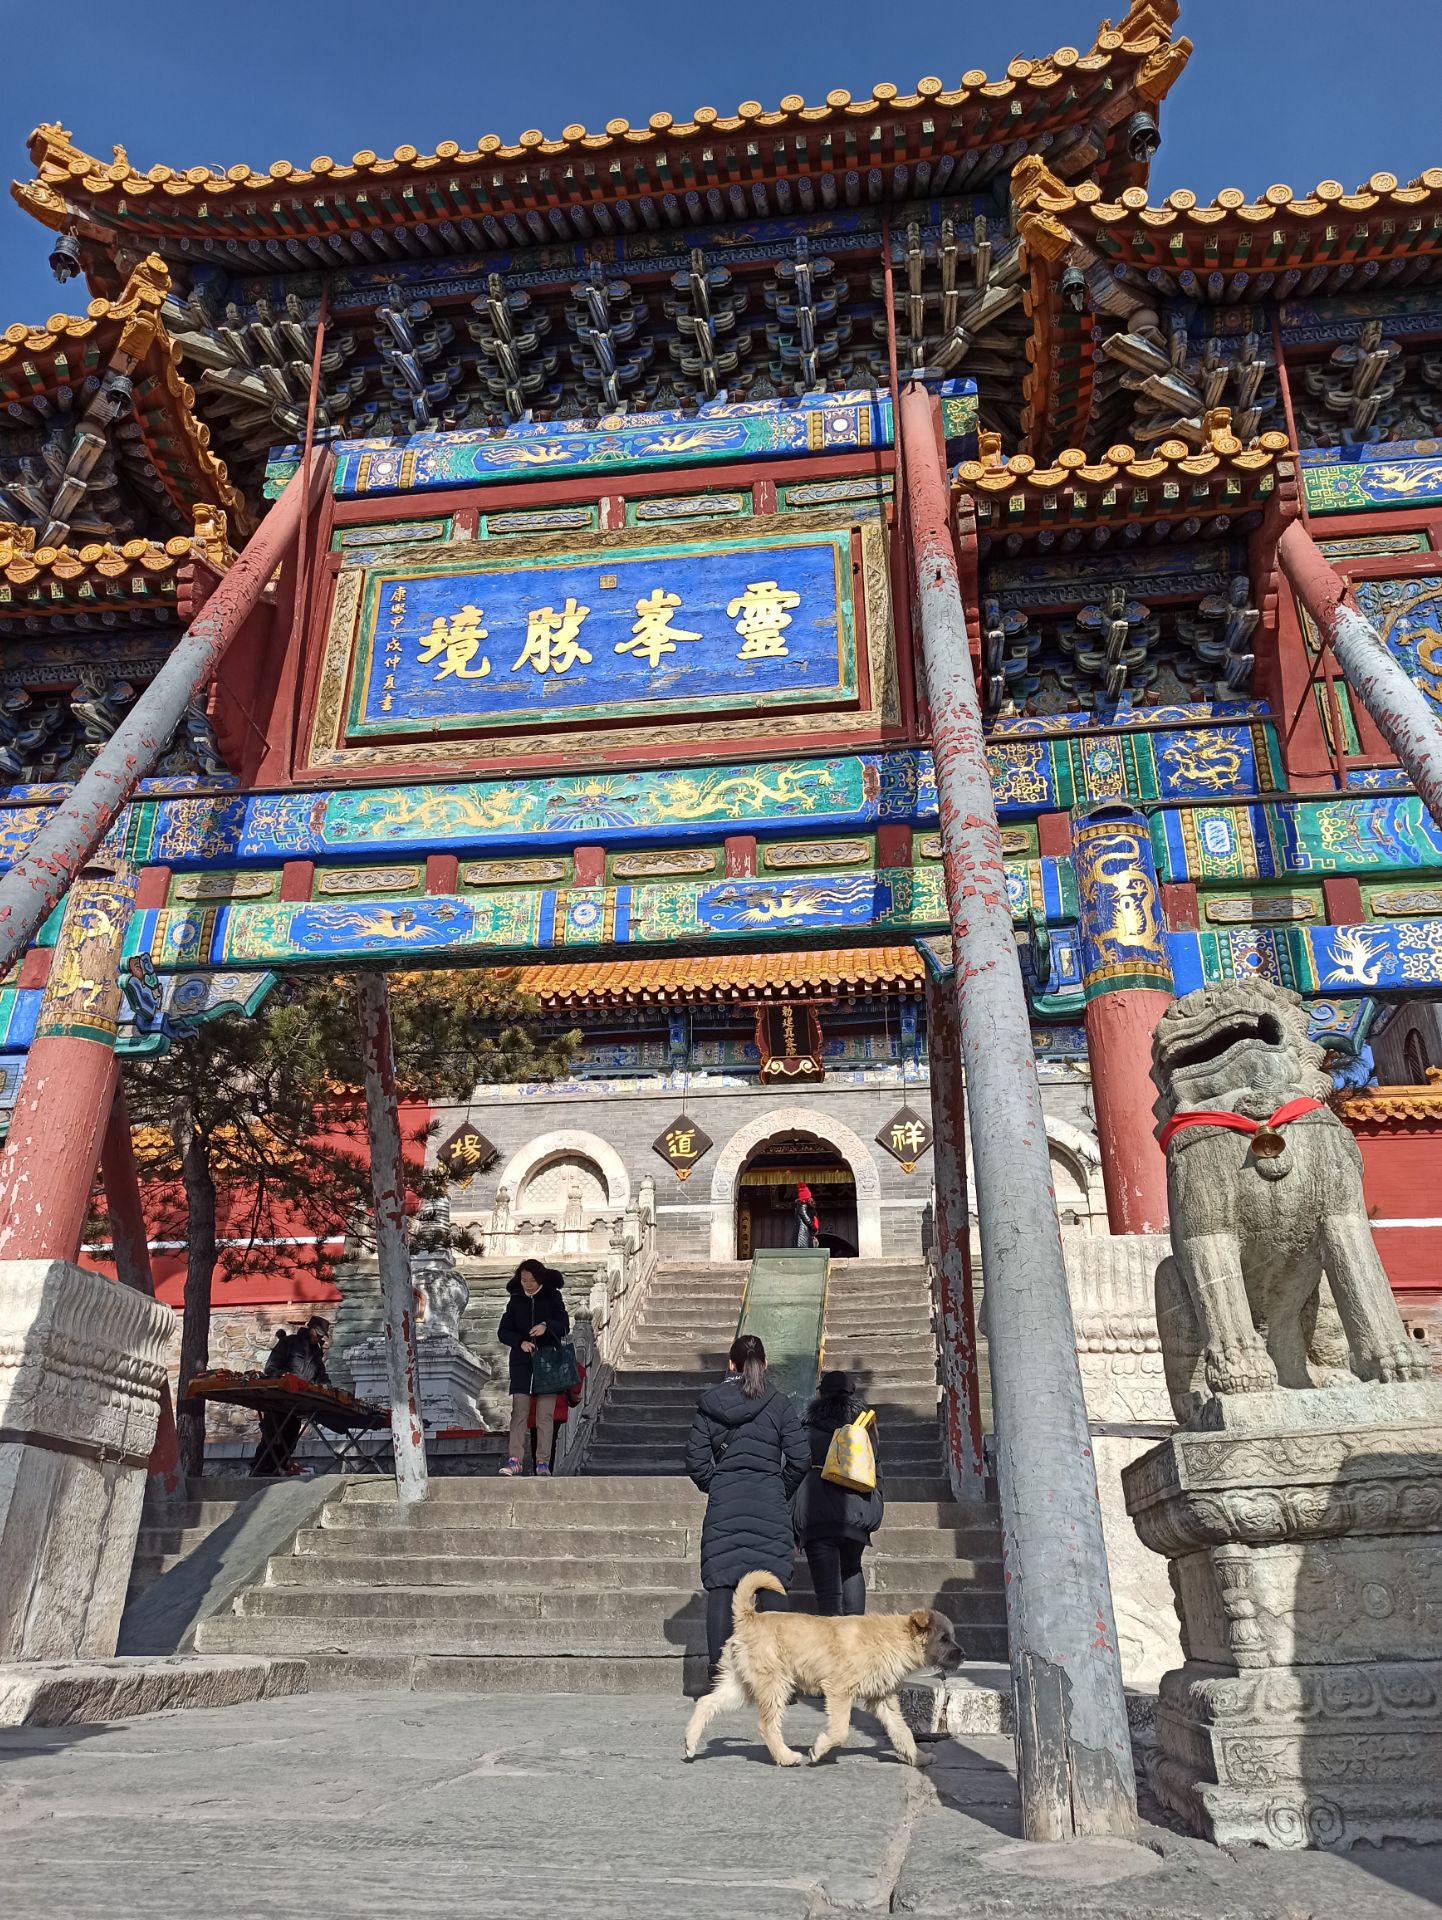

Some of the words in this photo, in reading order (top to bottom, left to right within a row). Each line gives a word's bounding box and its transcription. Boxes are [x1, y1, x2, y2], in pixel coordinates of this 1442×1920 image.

[450, 1134, 482, 1165] 場
[665, 1128, 698, 1158] 道
[890, 1119, 925, 1153] 祥
